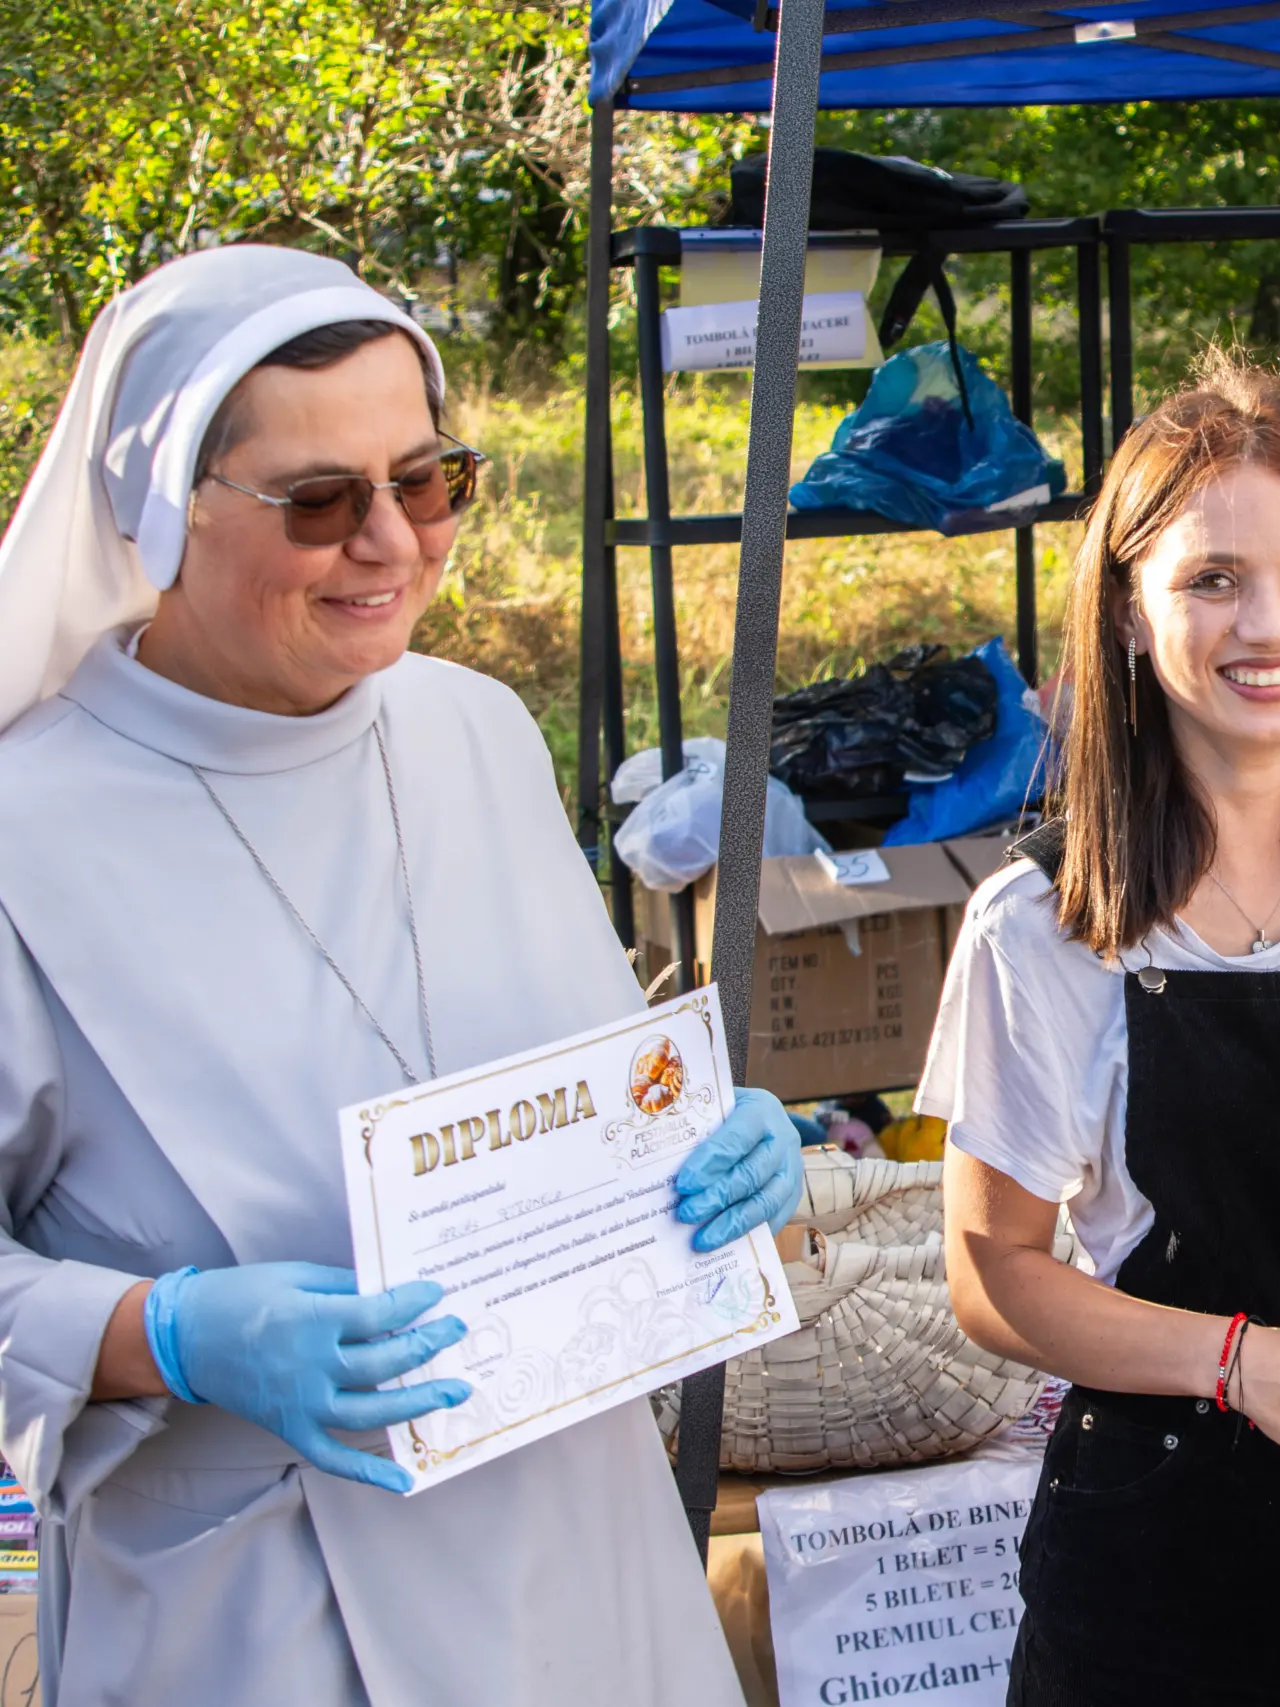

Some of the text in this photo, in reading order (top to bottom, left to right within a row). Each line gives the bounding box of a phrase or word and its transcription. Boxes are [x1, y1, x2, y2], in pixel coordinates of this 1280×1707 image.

[769, 956, 799, 973] ITEM
[876, 962, 899, 980] PCS
[884, 1023, 903, 1039] CM
[408, 1079, 598, 1177] DIPLOMA
[634, 1115, 691, 1145] FESTIVALUL
[684, 1270, 715, 1287] Comunei
[790, 1512, 921, 1553] TOMBOLĂ
[928, 1509, 963, 1532] DE
[877, 1556, 886, 1575] 1
[895, 1543, 968, 1573] BILET
[973, 1546, 988, 1556] =
[994, 1537, 1006, 1557] 5
[865, 1593, 878, 1613] 5
[884, 1577, 976, 1610] BILETE
[980, 1579, 995, 1590] =
[835, 1617, 965, 1655] PREMIUL
